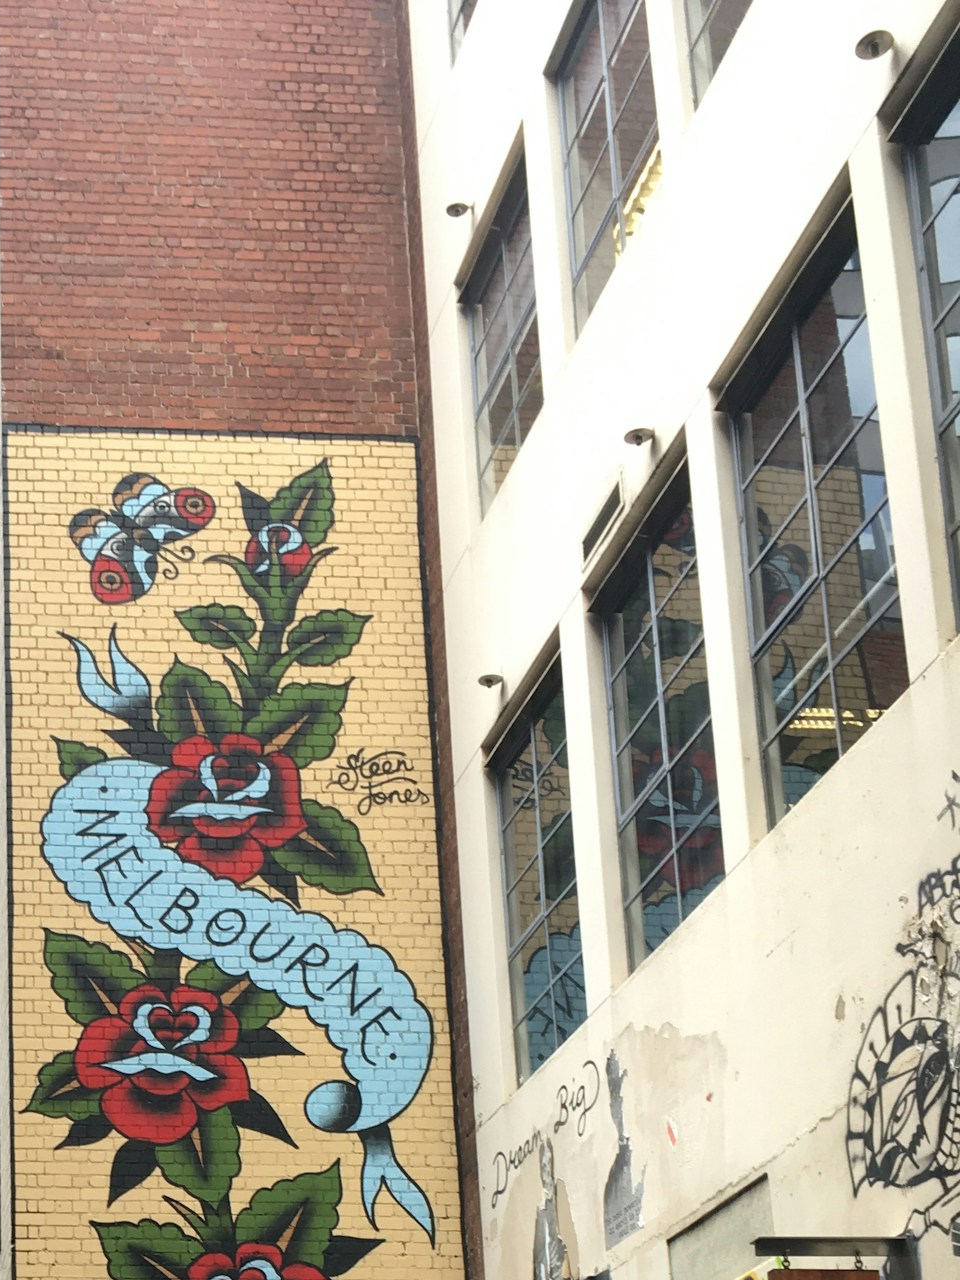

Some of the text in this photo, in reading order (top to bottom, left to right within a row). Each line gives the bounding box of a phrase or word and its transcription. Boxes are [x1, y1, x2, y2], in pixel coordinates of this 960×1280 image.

[326, 747, 414, 791] Steen
[73, 809, 403, 1066] MELBOURNE
[491, 1060, 600, 1210] Dream Big
